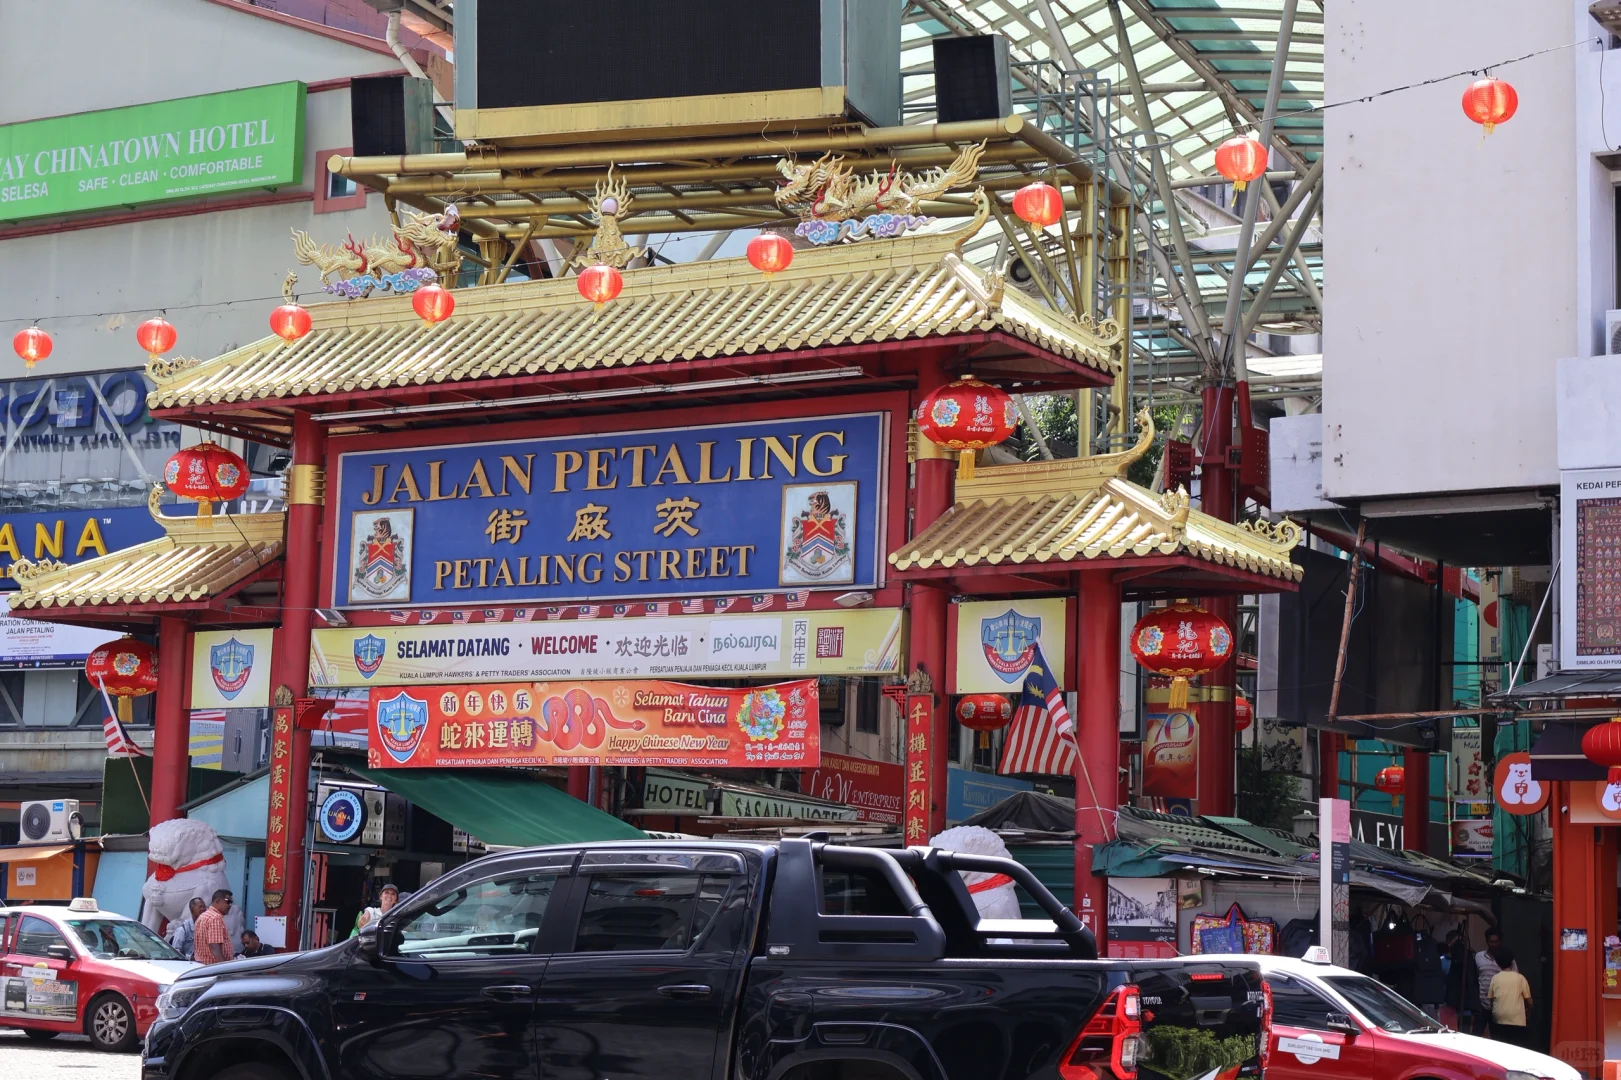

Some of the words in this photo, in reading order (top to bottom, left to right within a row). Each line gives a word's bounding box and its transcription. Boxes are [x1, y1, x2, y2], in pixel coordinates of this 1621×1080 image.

[0, 154, 30, 181] AY
[34, 131, 182, 176] CHINATOWN
[188, 119, 275, 154] HOTEL
[78, 176, 108, 192] SAFE
[120, 169, 158, 187] CLEAN
[170, 155, 263, 179] COMFORTABLE
[1, 181, 49, 202] SELESA
[361, 453, 537, 506] JALAN
[550, 430, 849, 493] PETALING
[1576, 481, 1603, 490] KEDAI
[433, 551, 604, 591] PETALING
[612, 545, 756, 583] STREET
[397, 638, 455, 660] SELAMAT
[456, 636, 511, 658] DATANG
[530, 634, 599, 656] WELCOME
[614, 634, 689, 658] 欢迎光临
[712, 632, 778, 652] நல்வரவு
[792, 620, 808, 668] 丙申年
[530, 668, 571, 676] ASSOCIATION
[650, 666, 674, 674] PERSATUAN
[674, 665, 693, 673] PENJAJA
[721, 663, 733, 672] KECIL
[734, 663, 748, 671] KUALA
[748, 663, 767, 671] LUMPUR
[442, 691, 531, 712] 新年快乐
[634, 691, 684, 707] Selamat
[687, 692, 729, 707] Tahun
[663, 709, 695, 724] Baru
[698, 709, 726, 724] Cina
[440, 719, 534, 749] 蛇來運轉
[609, 735, 640, 752] Happy
[642, 736, 679, 750] Chinese
[681, 736, 705, 749] New
[705, 736, 730, 749] Year
[1153, 741, 1186, 753] ANNIVERSARY
[435, 758, 465, 766] PERSATUAN
[690, 757, 728, 765] ASSOCIATION
[907, 702, 928, 841] 千攤並列賽
[821, 776, 835, 800] &
[835, 773, 853, 804] W
[852, 789, 901, 810] ENTERPRISE
